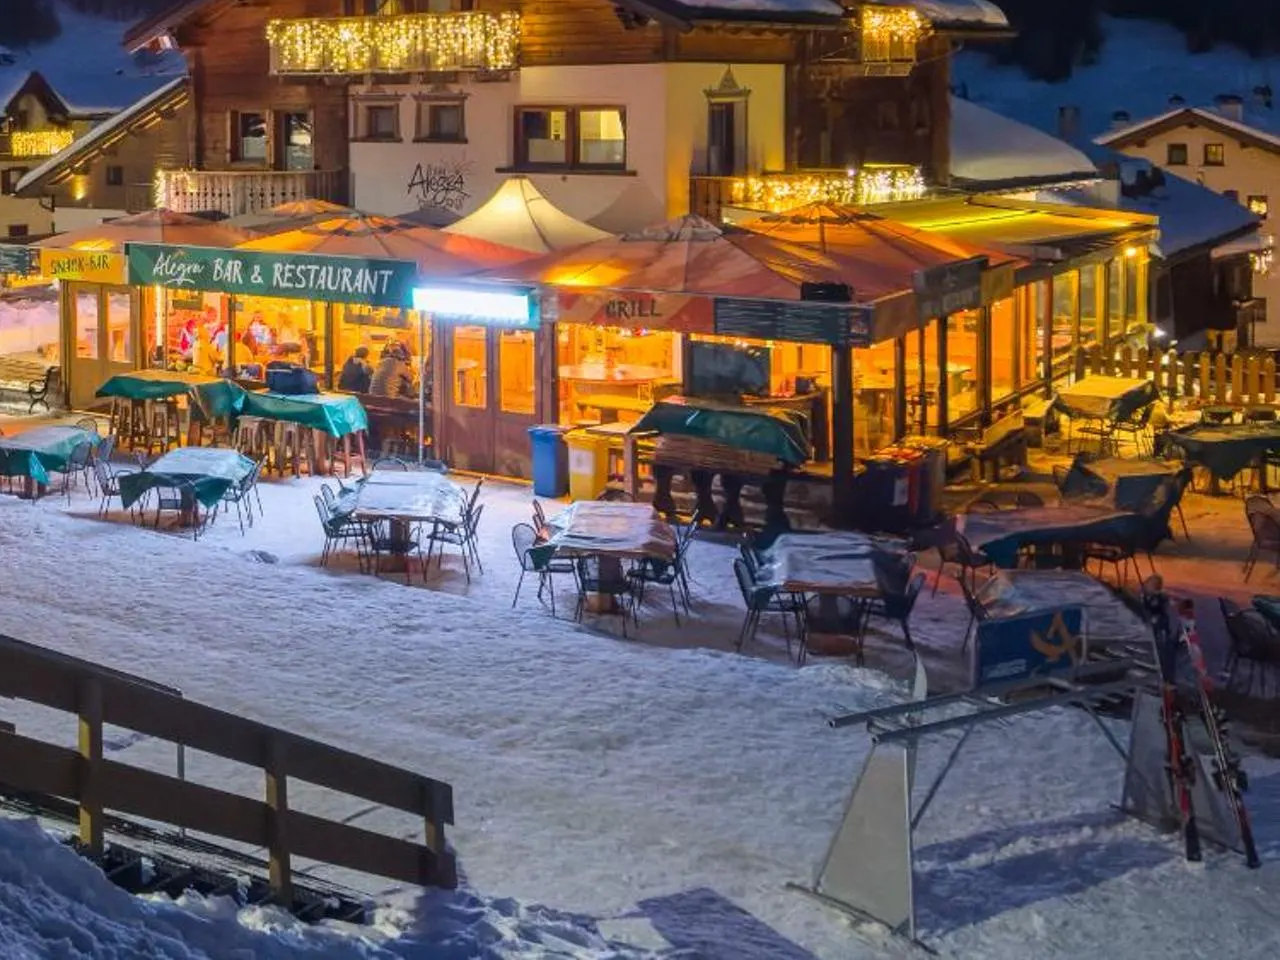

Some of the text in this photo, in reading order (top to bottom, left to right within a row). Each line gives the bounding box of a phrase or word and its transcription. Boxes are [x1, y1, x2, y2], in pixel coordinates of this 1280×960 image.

[152, 251, 394, 295] Alegra BAR & RESTAURANT
[605, 299, 662, 319] GRILL
